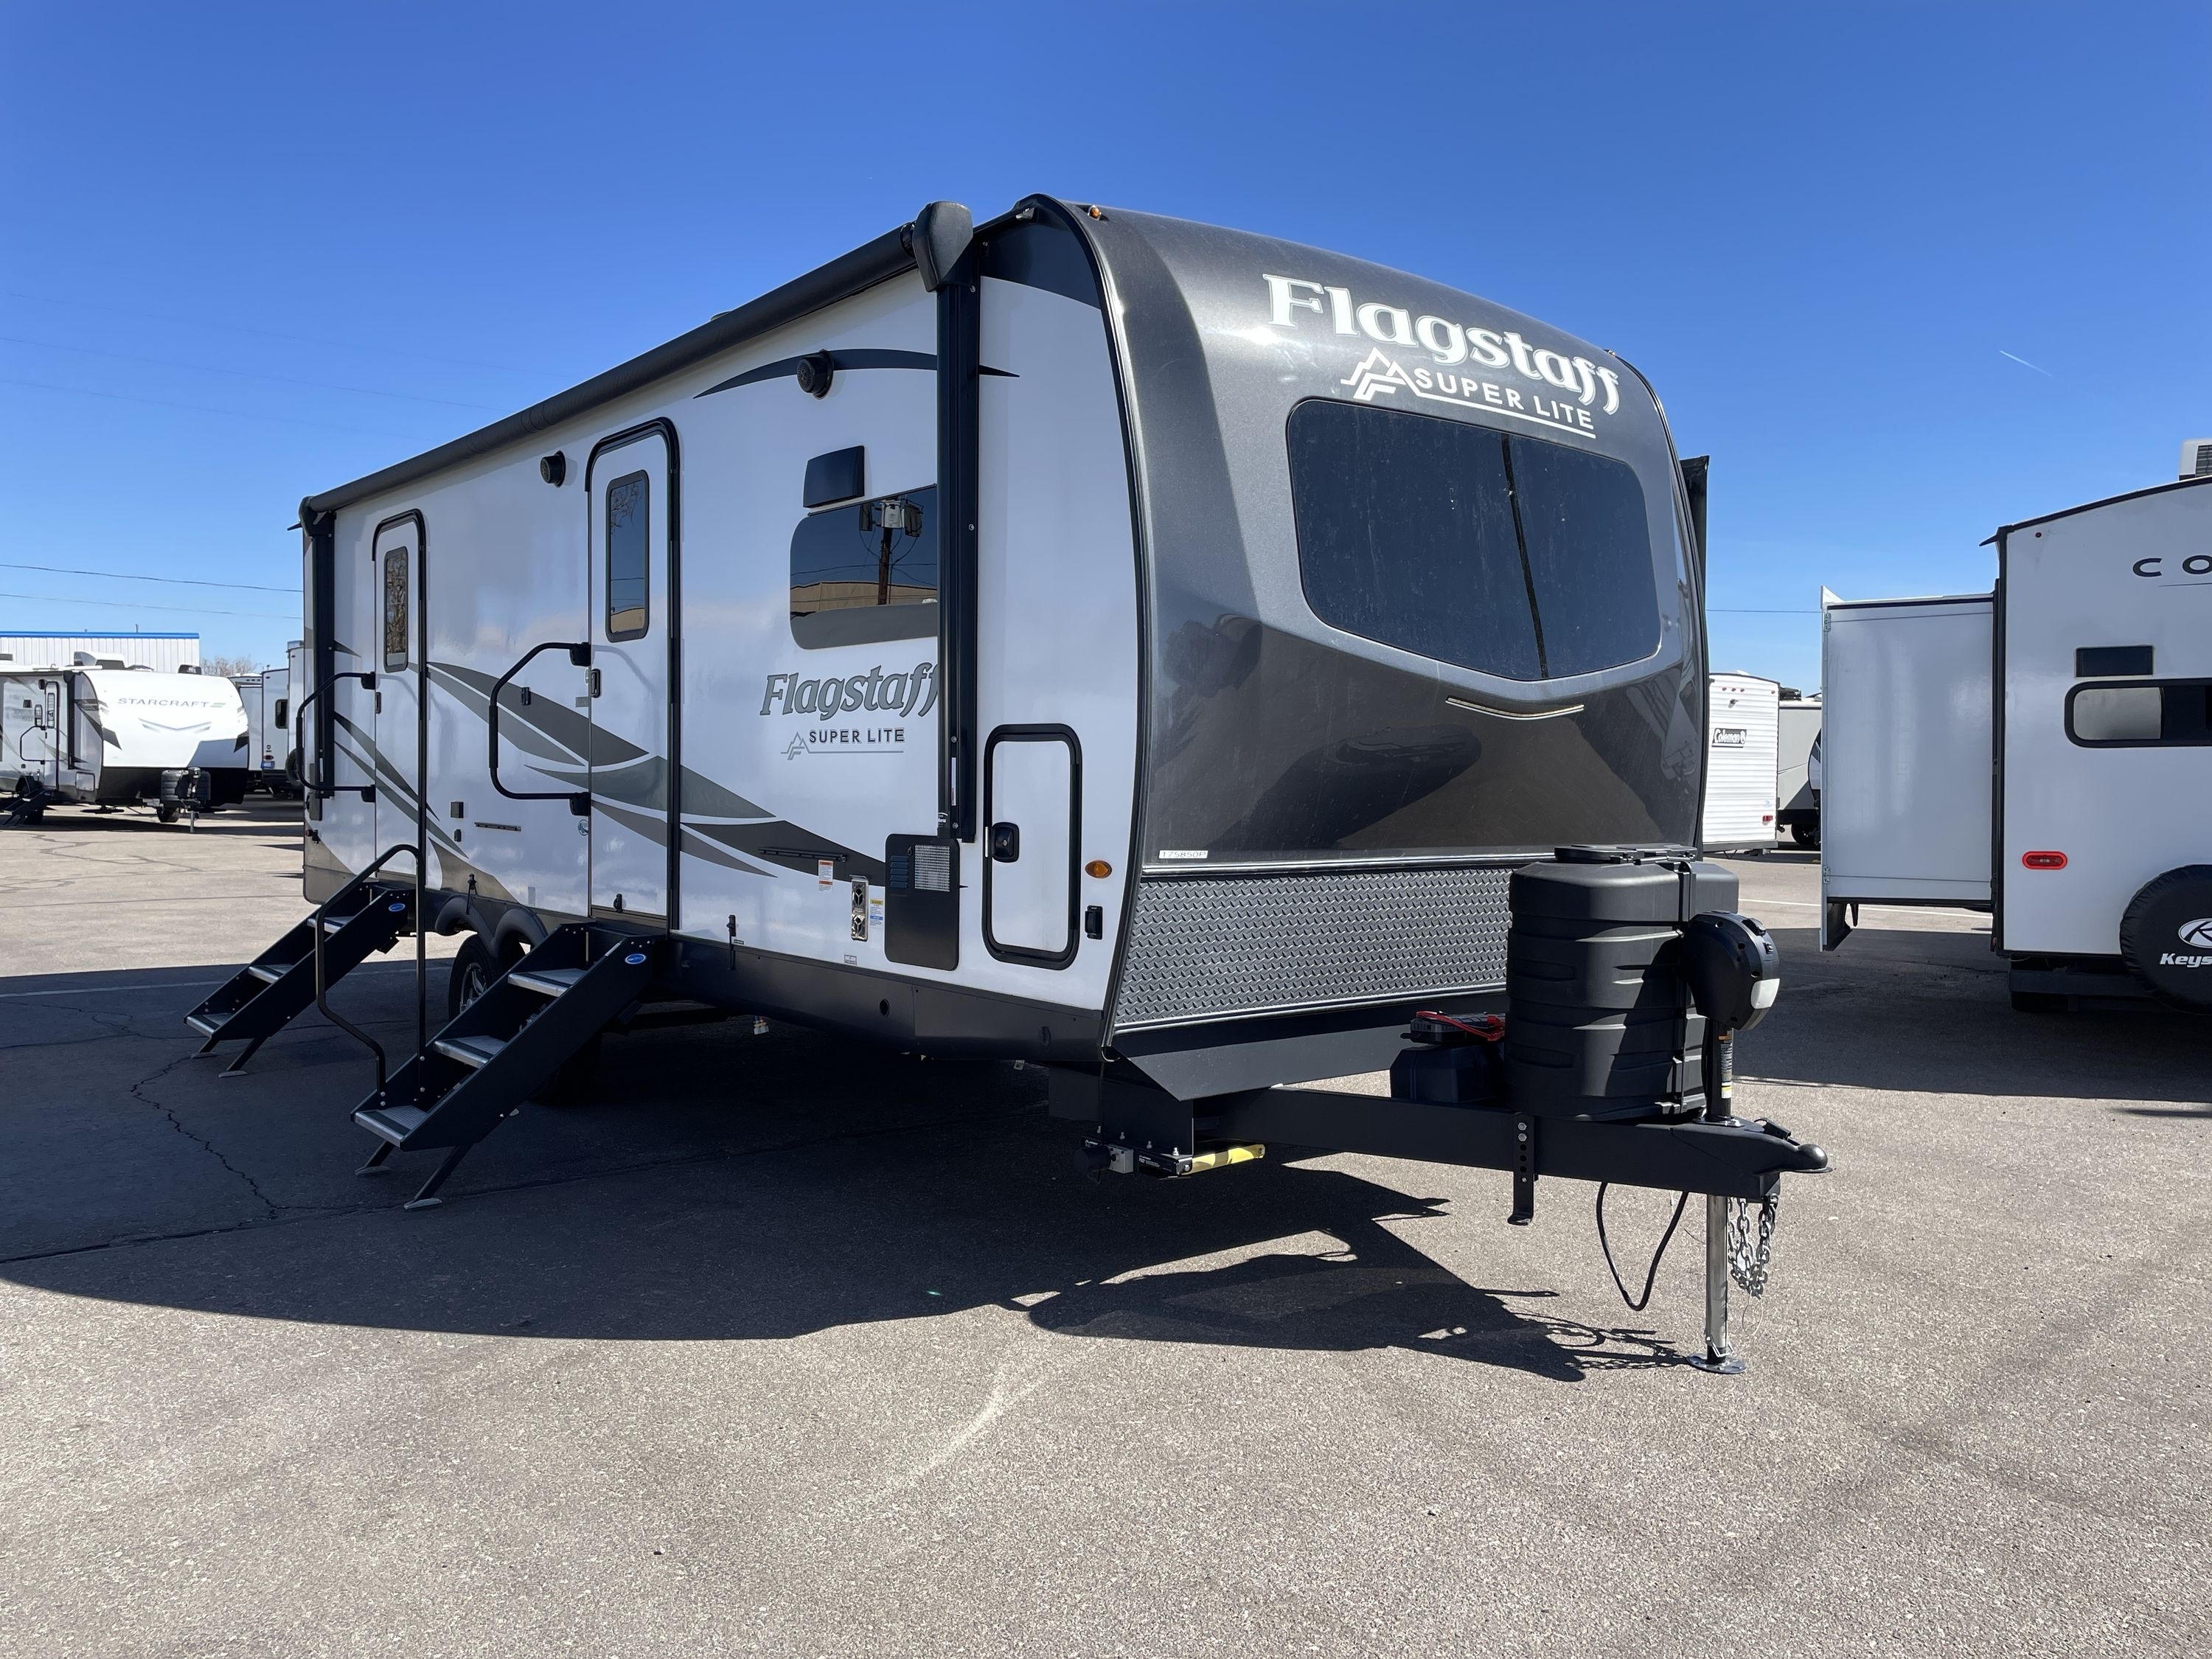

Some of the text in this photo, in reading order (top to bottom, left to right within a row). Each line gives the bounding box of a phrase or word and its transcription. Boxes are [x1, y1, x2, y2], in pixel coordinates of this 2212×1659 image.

[1262, 274, 1621, 415] Flagstaff
[1414, 368, 1594, 430] SUPER LITE
[759, 662, 938, 720] Flagstaff
[118, 698, 209, 708] STARCRAFT
[809, 728, 905, 743] SUPER LITE
[1714, 728, 1740, 743] Coleman
[2160, 953, 2212, 967] Keys
